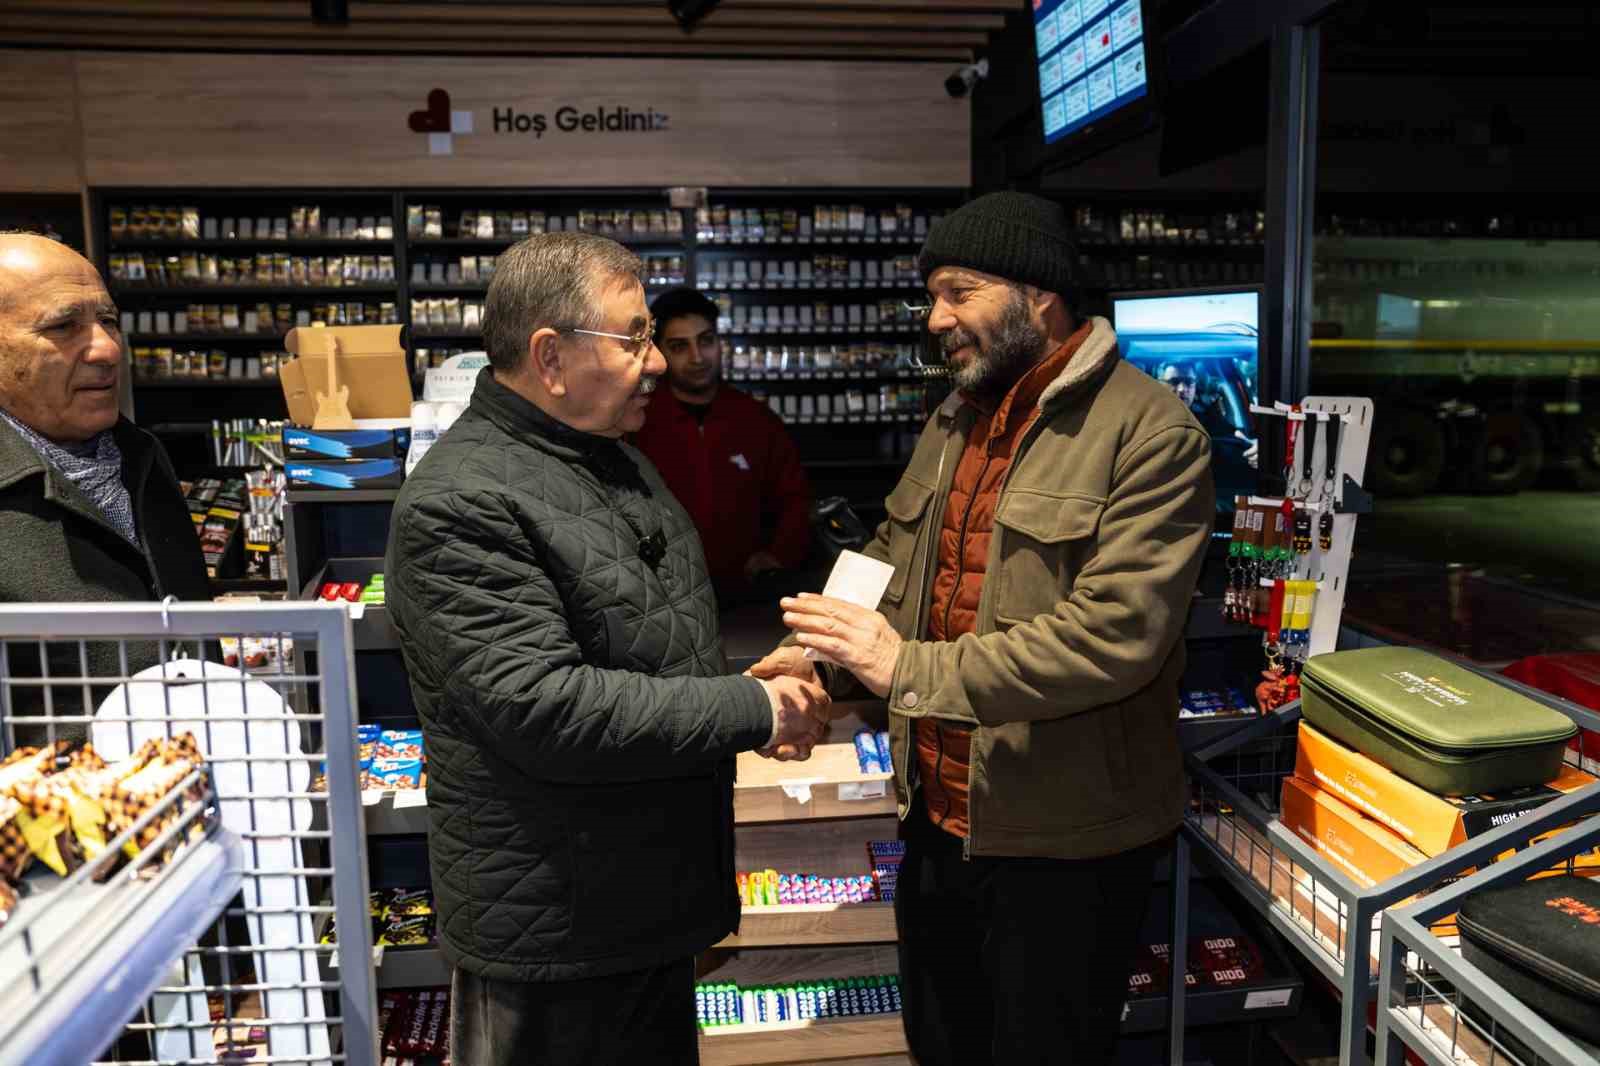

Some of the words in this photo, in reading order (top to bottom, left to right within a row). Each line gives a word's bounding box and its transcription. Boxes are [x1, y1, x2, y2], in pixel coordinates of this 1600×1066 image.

[493, 107, 547, 138] Hoş
[555, 106, 669, 132] Geldiniz
[1491, 812, 1516, 826] HIGH
